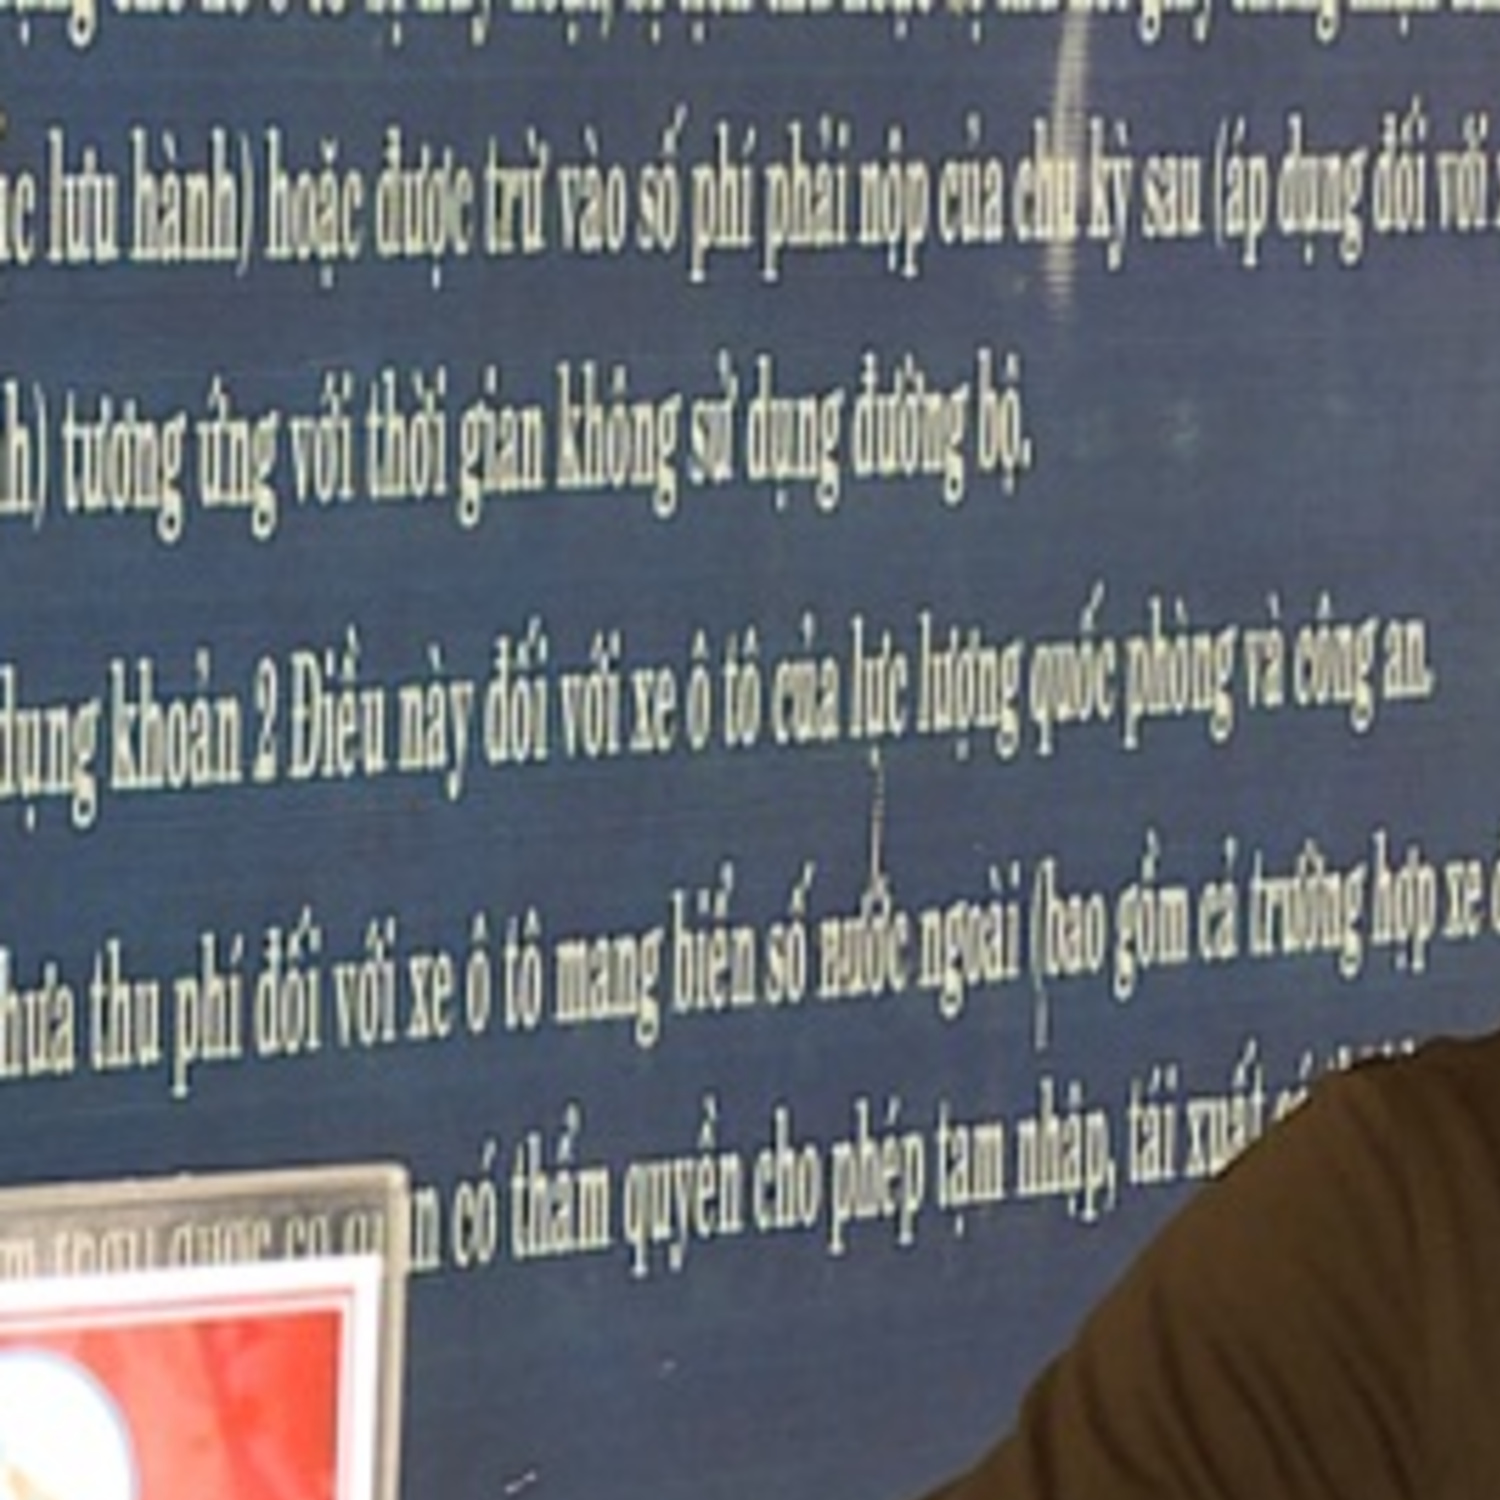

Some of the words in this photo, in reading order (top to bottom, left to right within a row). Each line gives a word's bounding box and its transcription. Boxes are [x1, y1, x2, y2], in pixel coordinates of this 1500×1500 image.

[47, 126, 119, 264] lưu
[130, 126, 254, 277] hành)
[265, 126, 364, 289] hoặc
[375, 126, 474, 289] được
[485, 126, 547, 255] trừ
[558, 126, 627, 252] vào
[636, 103, 688, 250] số
[691, 121, 756, 282] phí
[765, 114, 849, 282] phải
[859, 127, 929, 278] nộp
[938, 112, 1004, 243] của
[1087, 115, 1131, 270] kỳ
[1141, 154, 1202, 238] sau
[1214, 115, 1268, 267] (áp
[1277, 113, 1366, 266] dụng
[1373, 95, 1426, 230] đối
[1436, 112, 1488, 228] với
[62, 390, 187, 544] tương
[198, 375, 279, 540] ứng
[290, 370, 354, 503] với
[365, 367, 447, 498] thời
[458, 365, 546, 528] gian
[557, 360, 682, 519] không
[689, 349, 738, 484] sử
[747, 354, 846, 511] dụng
[853, 352, 970, 506] đường
[979, 347, 1032, 494] bộ.
[110, 645, 243, 790] khoản
[252, 655, 278, 781] 2
[288, 623, 387, 780] Điều
[398, 642, 474, 800] này
[482, 615, 548, 765] đối
[560, 629, 620, 757] với
[630, 665, 676, 753] xe
[686, 628, 710, 750] ô
[723, 626, 760, 746] tô
[772, 611, 840, 744] của
[850, 613, 907, 768] lực
[916, 610, 1024, 762] lượng
[1030, 580, 1115, 757] quốc
[1126, 595, 1239, 741] phòng
[1243, 592, 1284, 708] và
[1294, 590, 1379, 733] công
[1383, 618, 1434, 700] an.
[89, 937, 160, 1071] thu
[172, 932, 243, 1099] phí
[255, 904, 321, 1057] đối
[333, 915, 396, 1047] với
[406, 948, 454, 1040] xe
[465, 911, 491, 1034] ô
[505, 908, 542, 1030] tô
[556, 925, 663, 1049] mang
[672, 861, 755, 1014] biển
[765, 861, 815, 1004] số
[918, 862, 1020, 1019] ngoài
[1032, 857, 1105, 992] (bao
[1113, 829, 1189, 1001] gồm
[1200, 837, 1238, 960] cả
[1249, 838, 1367, 978] trường
[1371, 829, 1437, 972] hợp
[1443, 859, 1482, 938] xe
[453, 1140, 497, 1268] có
[510, 1103, 612, 1258] thẩm
[623, 1095, 742, 1280] quyền
[752, 1106, 822, 1232] cho
[829, 1097, 925, 1254] phép
[936, 1100, 1003, 1237] tạm
[1016, 1076, 1115, 1222] nhập,
[1127, 1064, 1177, 1185] tái
